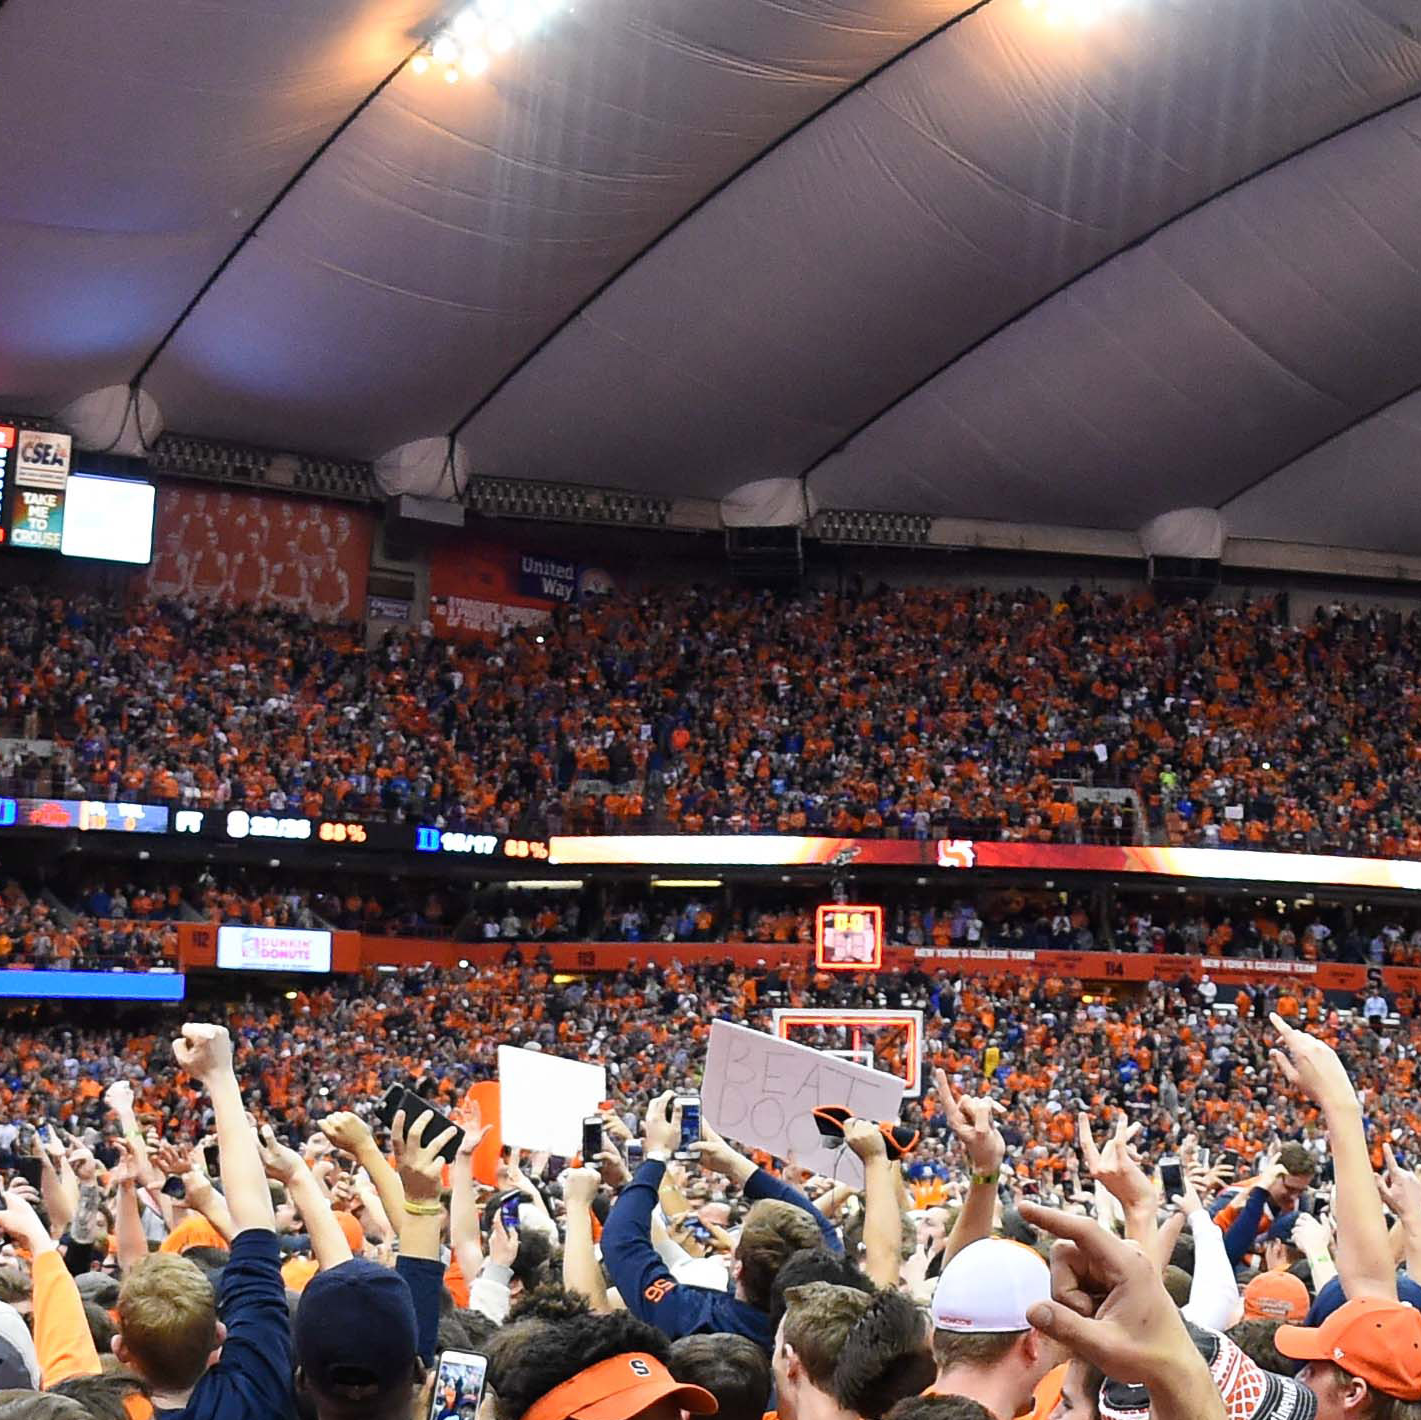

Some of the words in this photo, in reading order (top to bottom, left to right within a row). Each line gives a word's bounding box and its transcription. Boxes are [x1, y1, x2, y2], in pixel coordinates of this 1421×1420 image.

[21, 442, 64, 465] CSEA
[23, 492, 57, 507] TAKE
[28, 507, 49, 519] ME
[28, 518, 48, 531] TO
[522, 556, 574, 580] United
[541, 577, 574, 601] Way
[722, 1031, 881, 1109] BEAT
[630, 1359, 650, 1377] S
